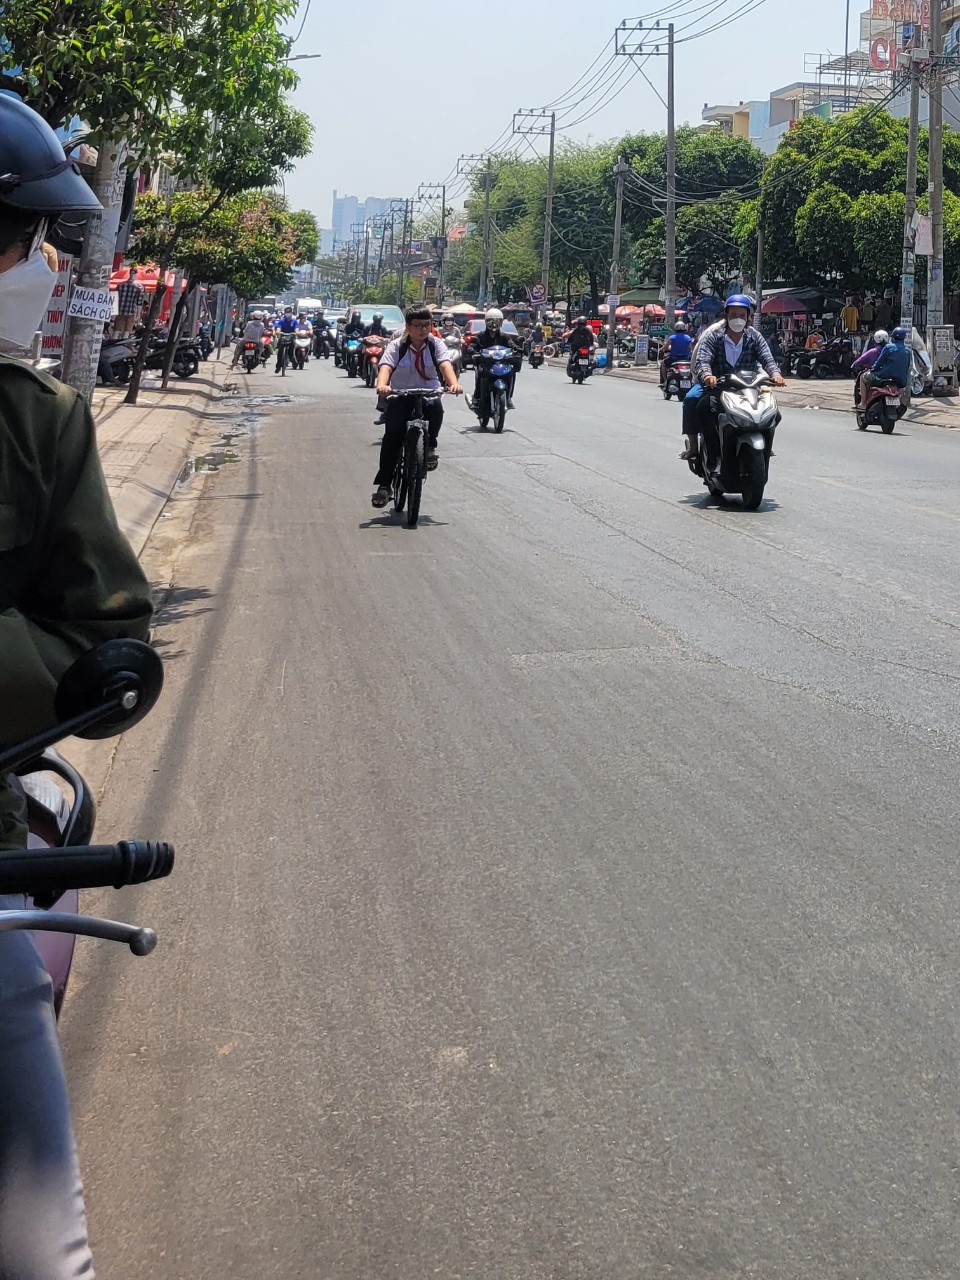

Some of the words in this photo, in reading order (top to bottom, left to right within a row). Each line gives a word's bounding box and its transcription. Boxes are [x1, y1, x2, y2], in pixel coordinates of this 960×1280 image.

[74, 288, 95, 304] MUA
[97, 290, 115, 307] BÁN
[47, 307, 64, 323] THÚY
[70, 301, 98, 318] SÁCH
[99, 304, 112, 320] CŨ
